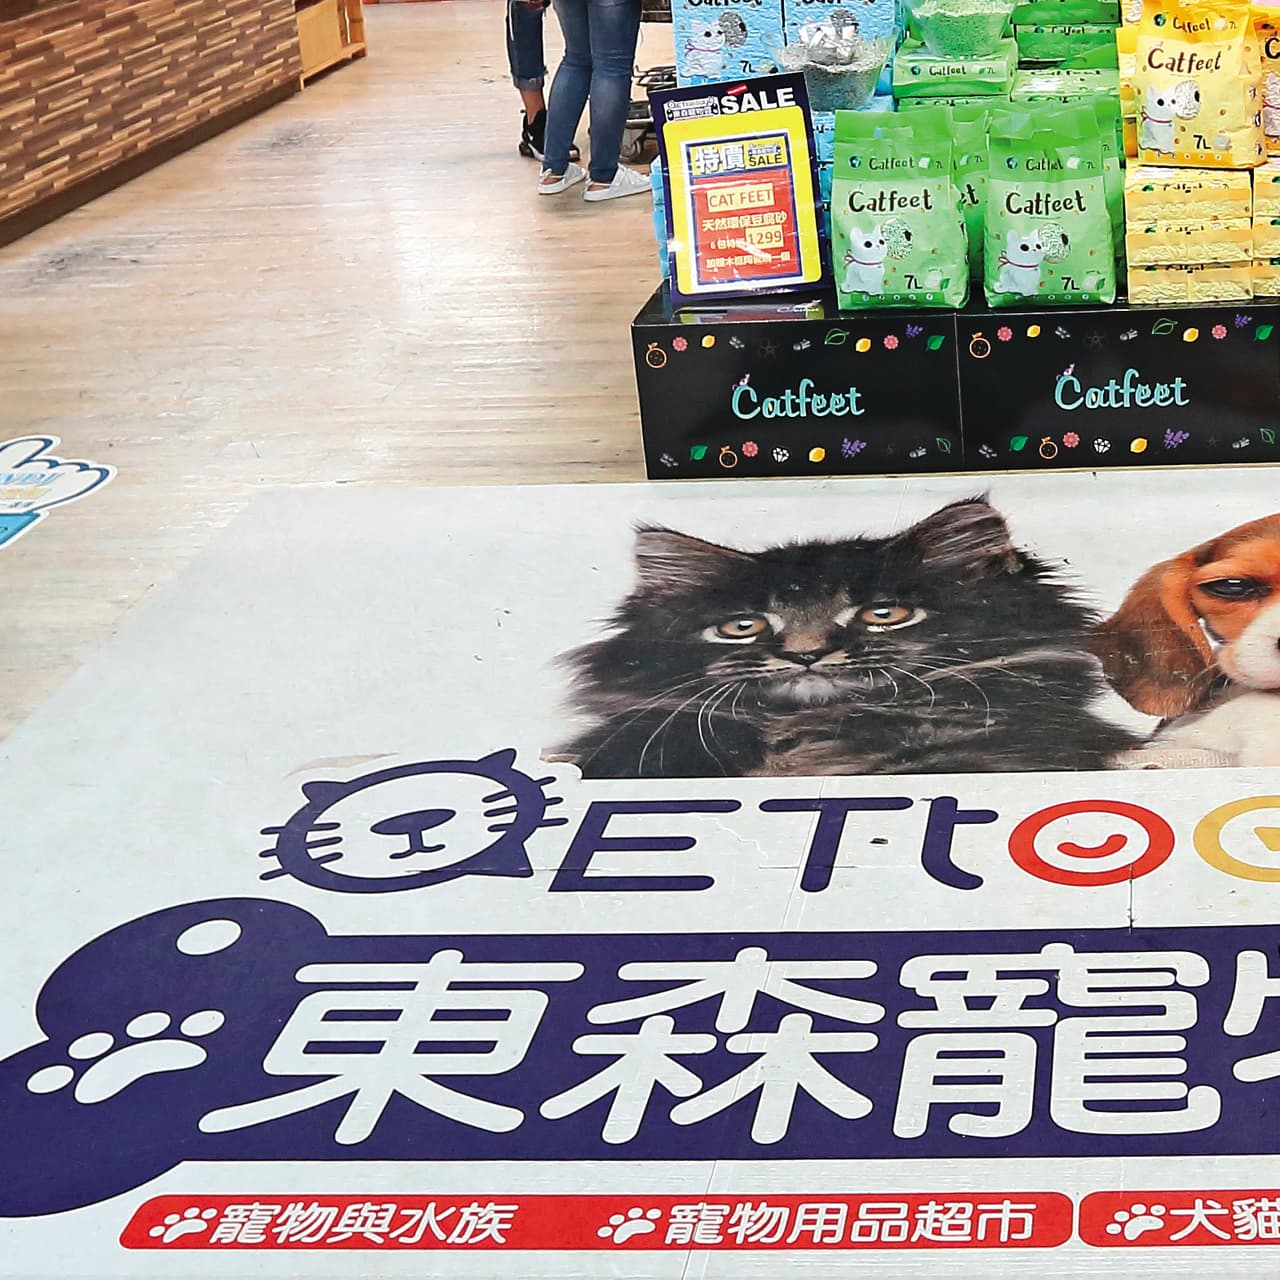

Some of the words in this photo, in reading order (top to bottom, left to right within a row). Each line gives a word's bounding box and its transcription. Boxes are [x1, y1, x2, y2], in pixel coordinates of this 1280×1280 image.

[1173, 17, 1211, 33] Catfeet
[739, 60, 756, 74] 7L
[1147, 47, 1222, 73] Catfeet
[929, 65, 967, 76] Catfeet
[720, 87, 796, 115] SALE
[1192, 135, 1212, 150] 7L
[694, 144, 746, 172] 特價
[749, 154, 783, 167] SALE
[869, 155, 915, 171] Catfeet
[709, 193, 736, 208] CAT
[740, 189, 773, 203] FEET
[848, 188, 933, 214] Catfeet
[1005, 189, 1087, 215] Catfeet
[702, 211, 788, 232] 天然環保豆腐砂
[747, 229, 783, 245] 1299
[903, 275, 923, 290] 7L
[1061, 276, 1081, 291] 7L
[1054, 362, 1190, 411] Catfeet
[731, 377, 866, 421] Catfeet
[208, 1199, 520, 1245] 寵物與水族
[663, 1199, 1037, 1245] 寵物用品超市
